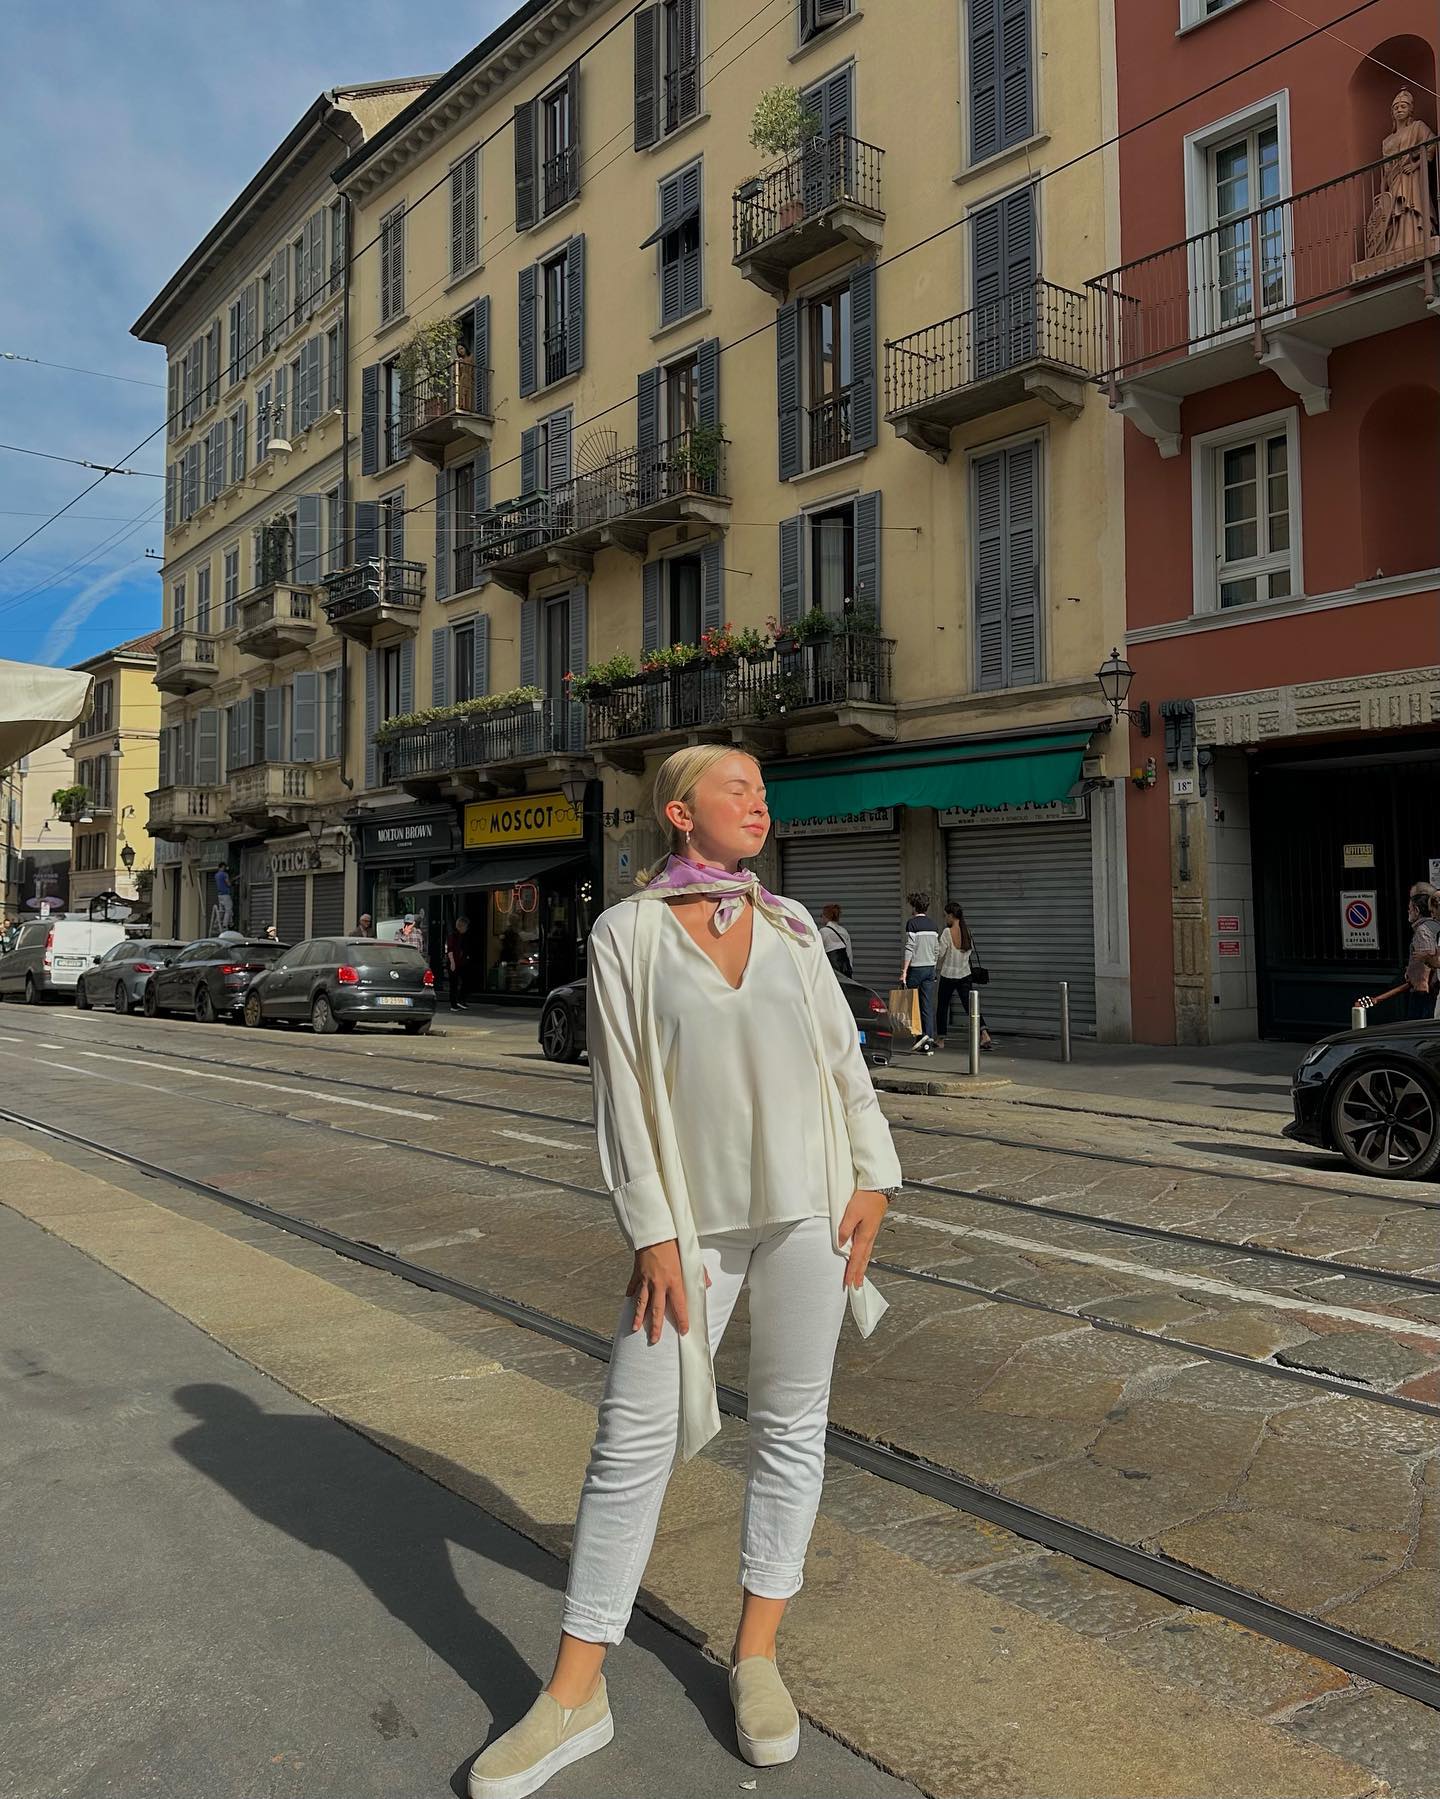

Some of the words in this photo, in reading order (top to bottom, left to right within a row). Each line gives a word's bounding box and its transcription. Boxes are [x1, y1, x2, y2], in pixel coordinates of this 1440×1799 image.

[490, 807, 552, 833] MOSCOT
[841, 812, 865, 823] casa
[869, 809, 889, 821] tua
[378, 827, 404, 842] MOLTON
[405, 824, 432, 839] BROWN
[271, 851, 309, 873] OTTICA
